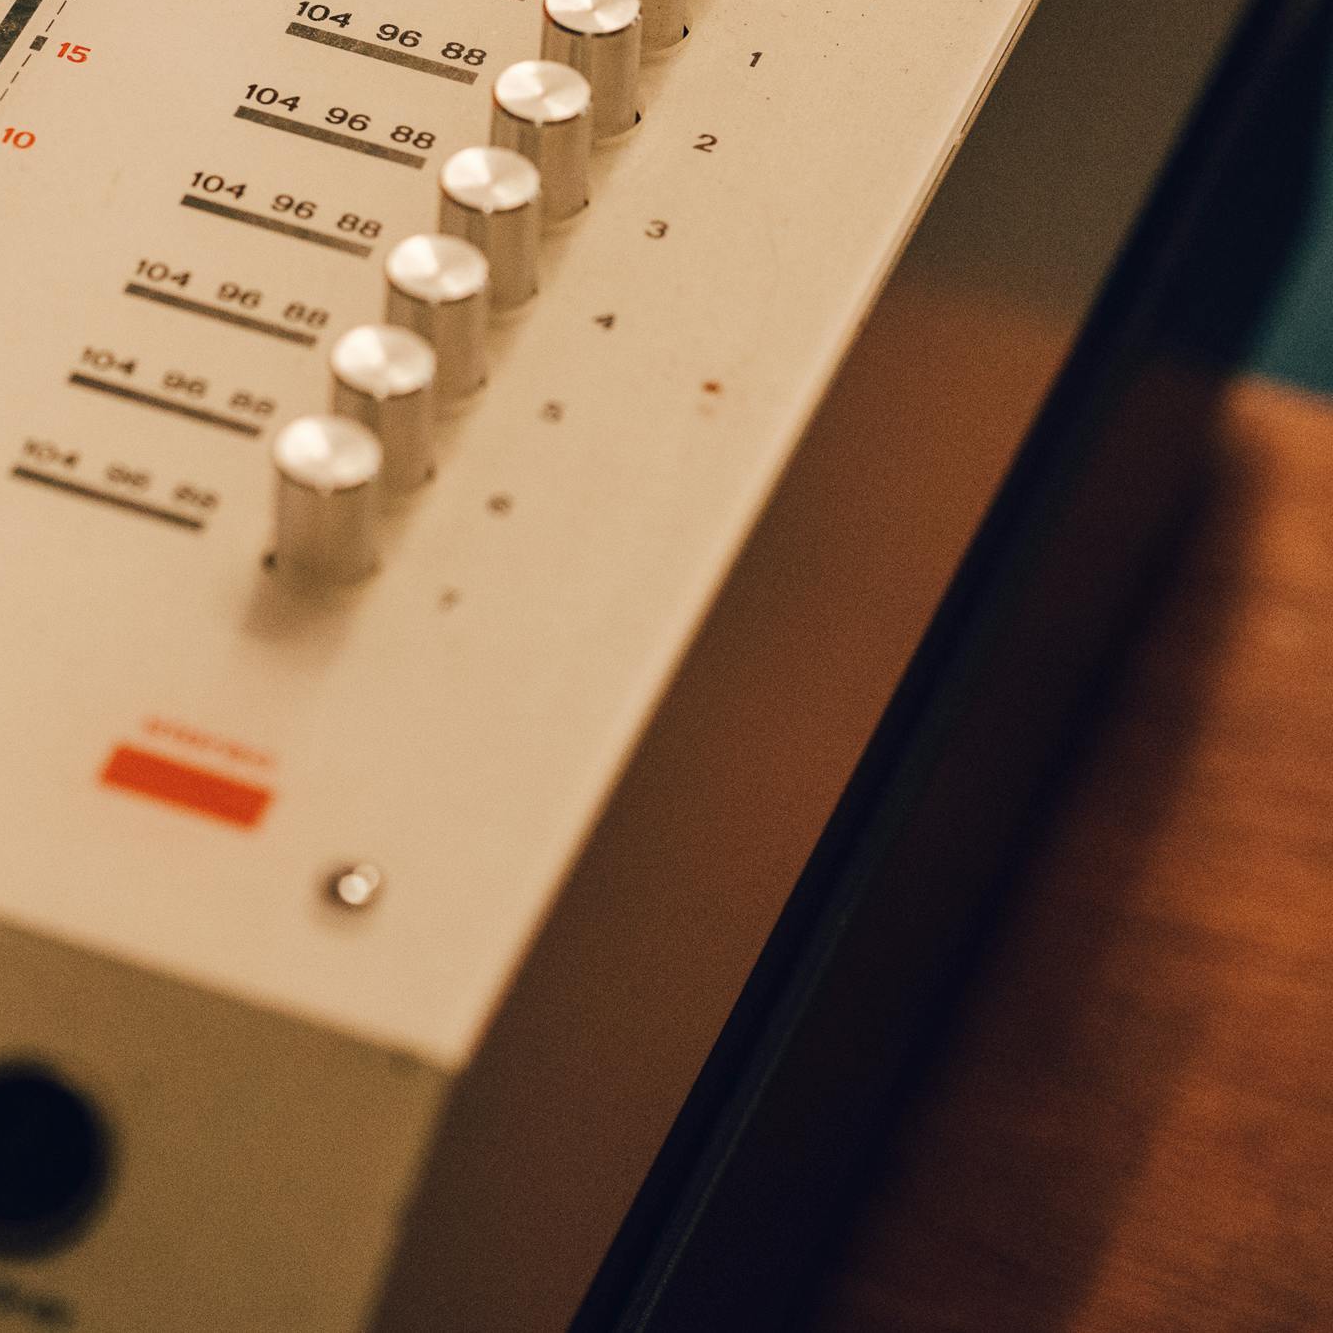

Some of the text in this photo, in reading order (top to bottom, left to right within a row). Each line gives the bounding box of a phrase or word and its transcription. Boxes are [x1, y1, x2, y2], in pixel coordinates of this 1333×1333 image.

[295, 0, 487, 67] 104 96 88
[56, 41, 92, 64] 15
[749, 52, 762, 68] 1
[244, 83, 436, 151] 104 96 88
[1, 127, 36, 150] 10
[693, 133, 719, 153] 2
[190, 171, 383, 240] 104 96 88
[645, 220, 669, 240] 3
[134, 259, 329, 328] 104 96 88
[593, 311, 617, 331] 4
